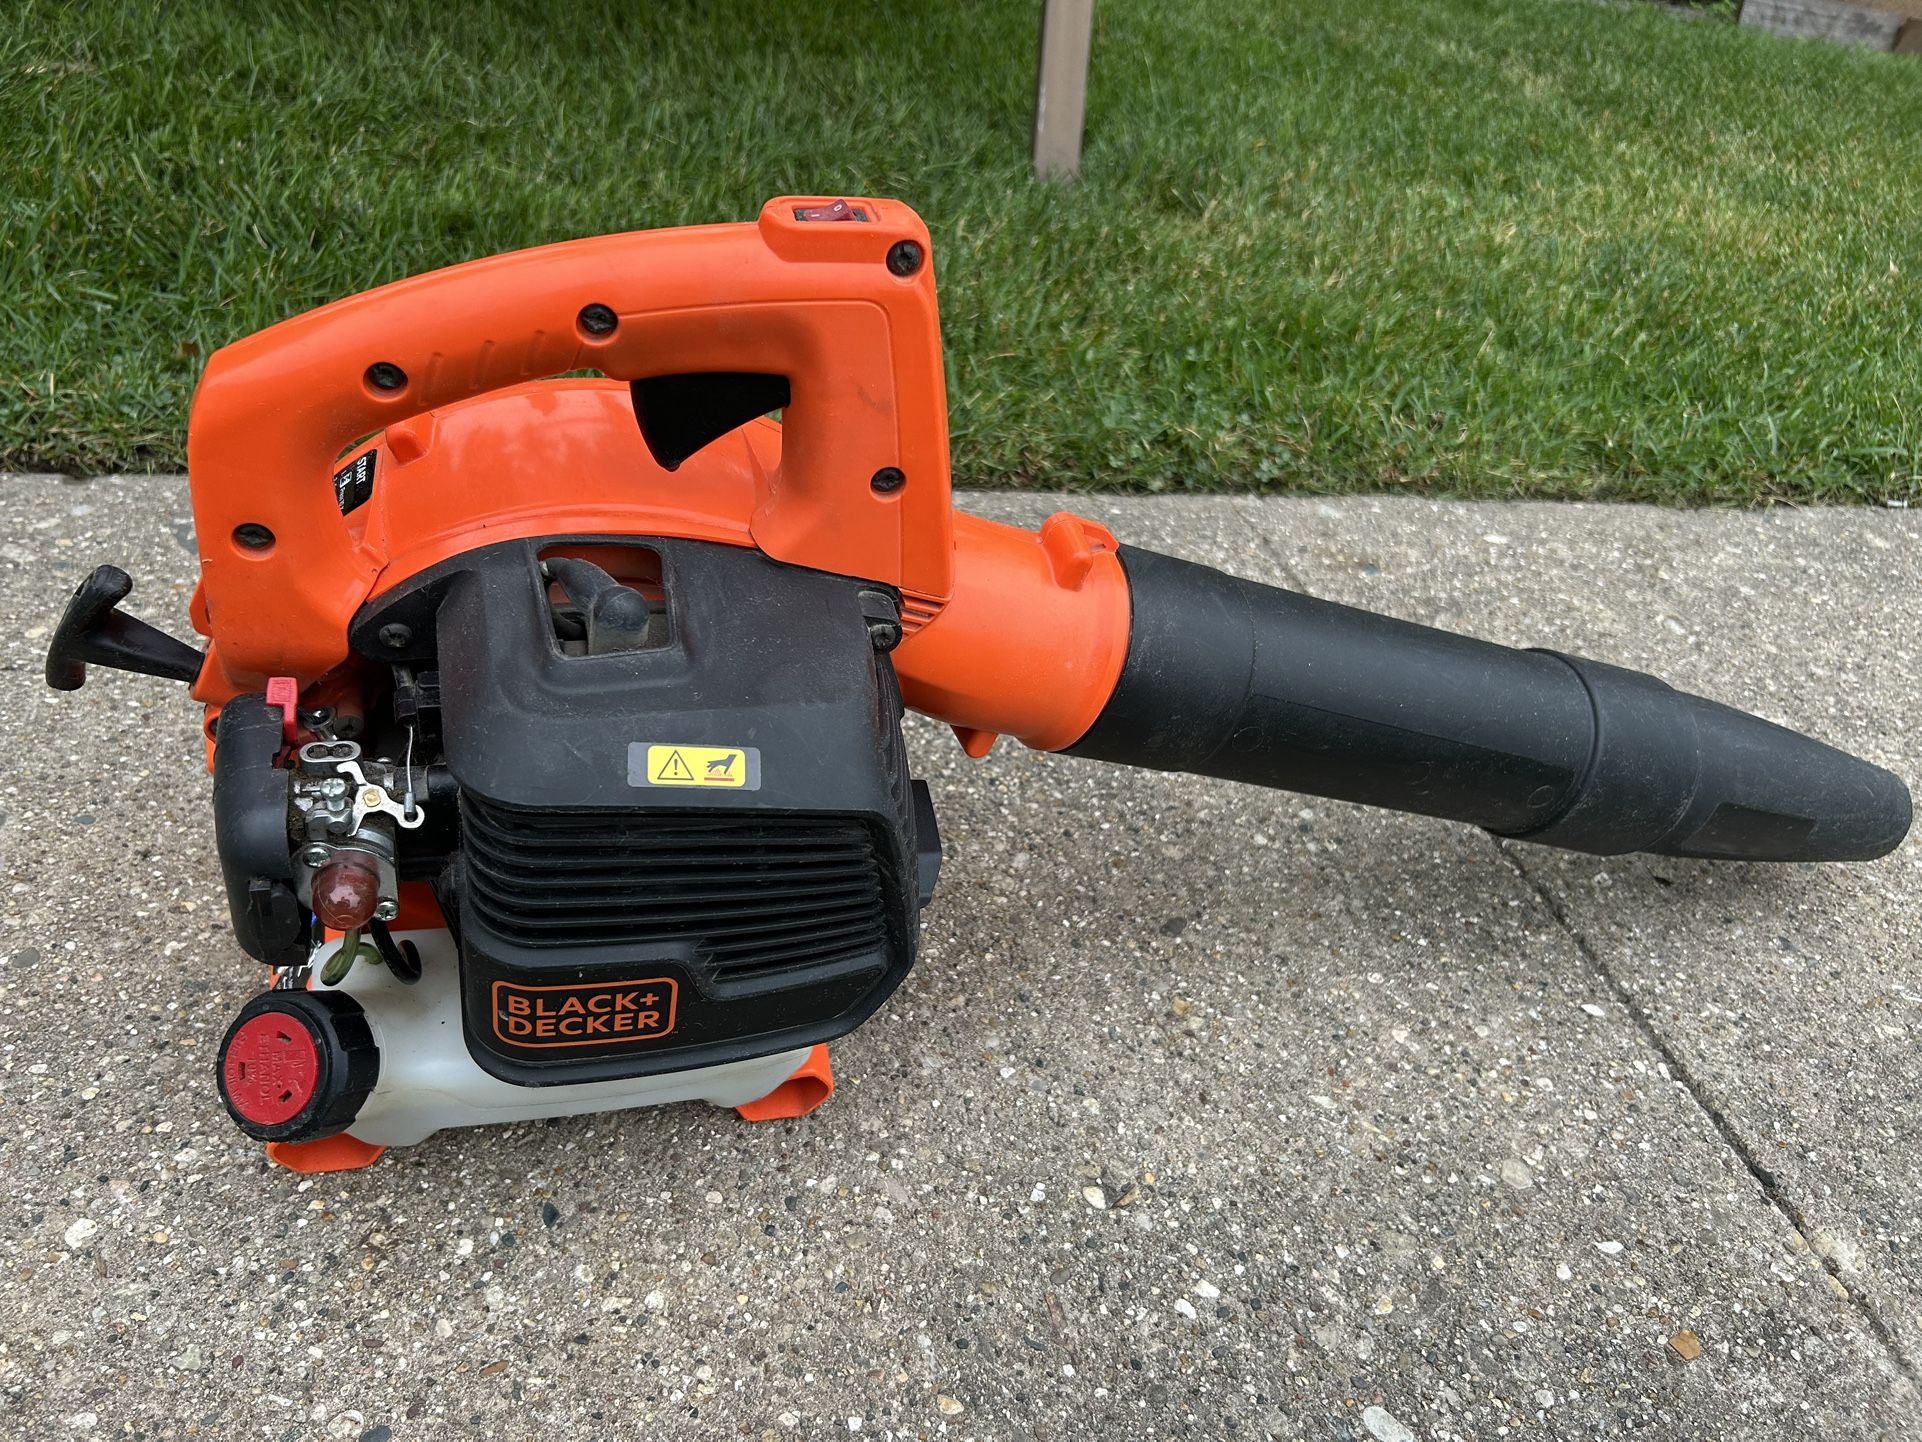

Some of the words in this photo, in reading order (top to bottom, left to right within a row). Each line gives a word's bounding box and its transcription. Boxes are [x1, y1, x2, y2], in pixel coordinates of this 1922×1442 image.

[356, 457, 366, 484] START
[508, 991, 660, 1017] BLACK+
[508, 1010, 660, 1038] DECKER
[247, 1057, 257, 1086] 10%
[259, 1033, 272, 1106] ETHANOL
